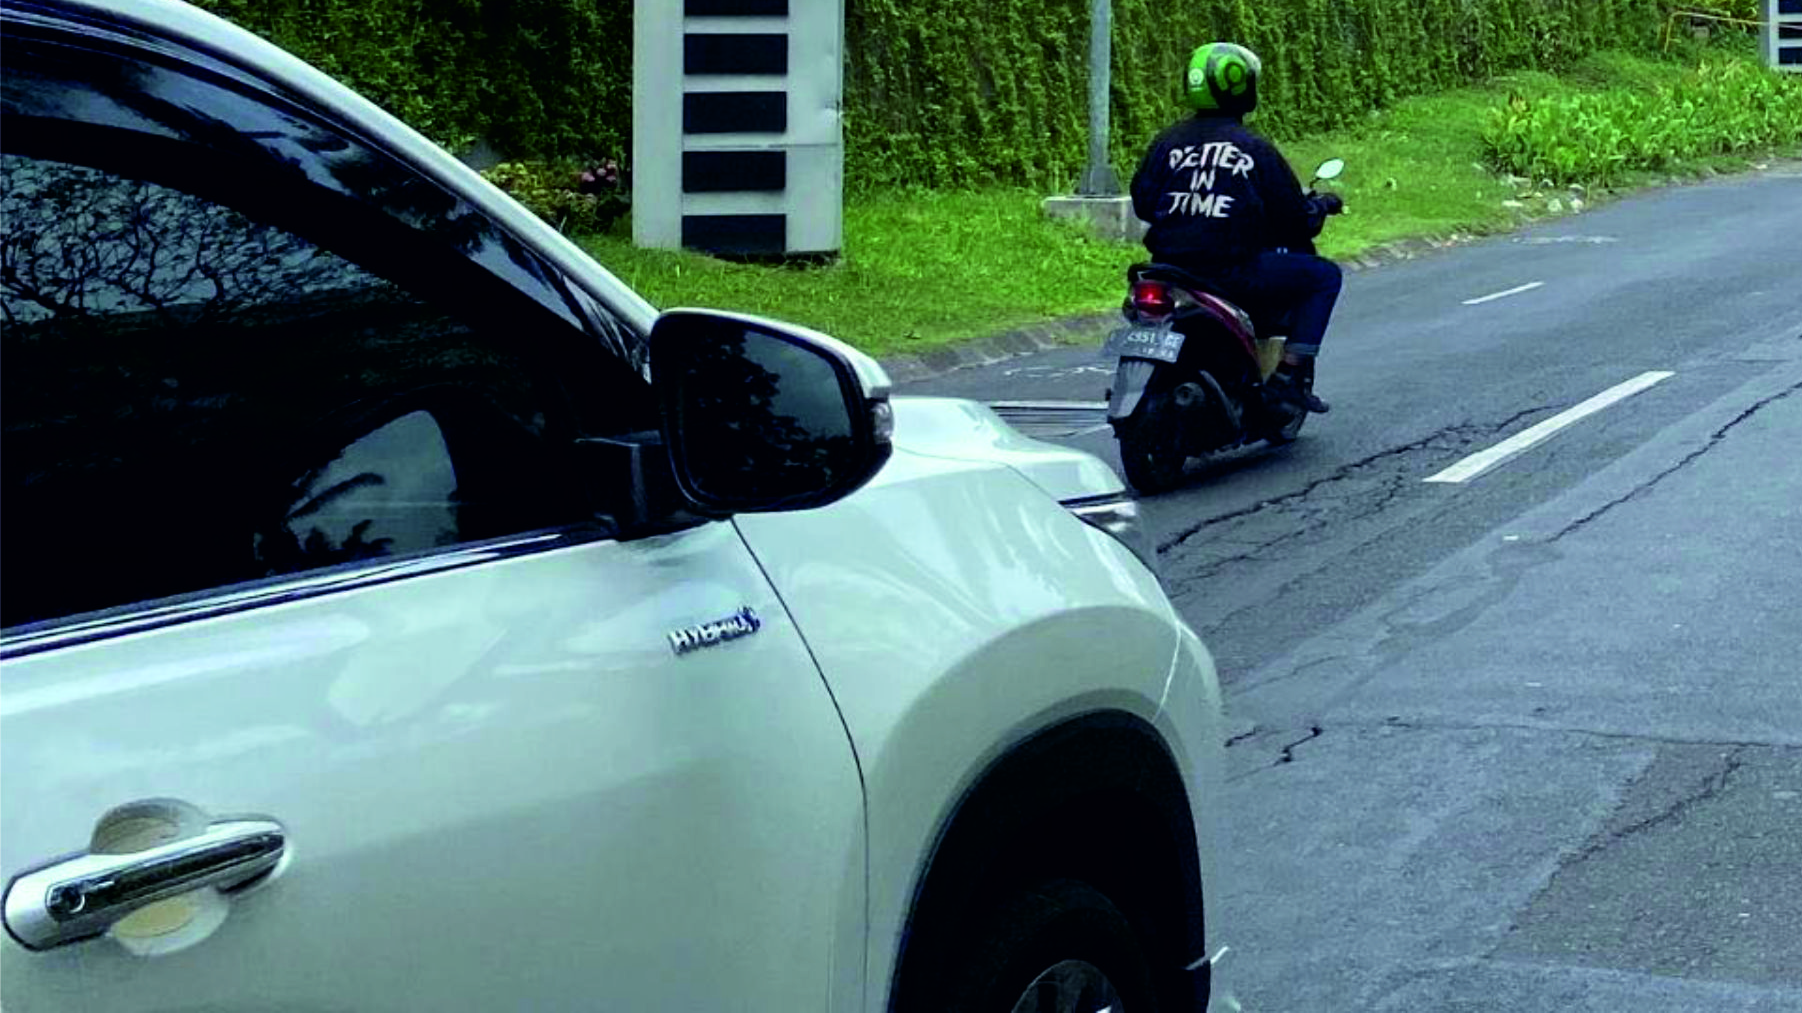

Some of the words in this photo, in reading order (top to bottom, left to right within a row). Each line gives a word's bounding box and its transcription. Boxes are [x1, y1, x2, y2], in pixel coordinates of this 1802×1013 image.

[1190, 167, 1216, 191] IN
[1165, 191, 1235, 218] TIME
[667, 609, 758, 655] HYBRID
